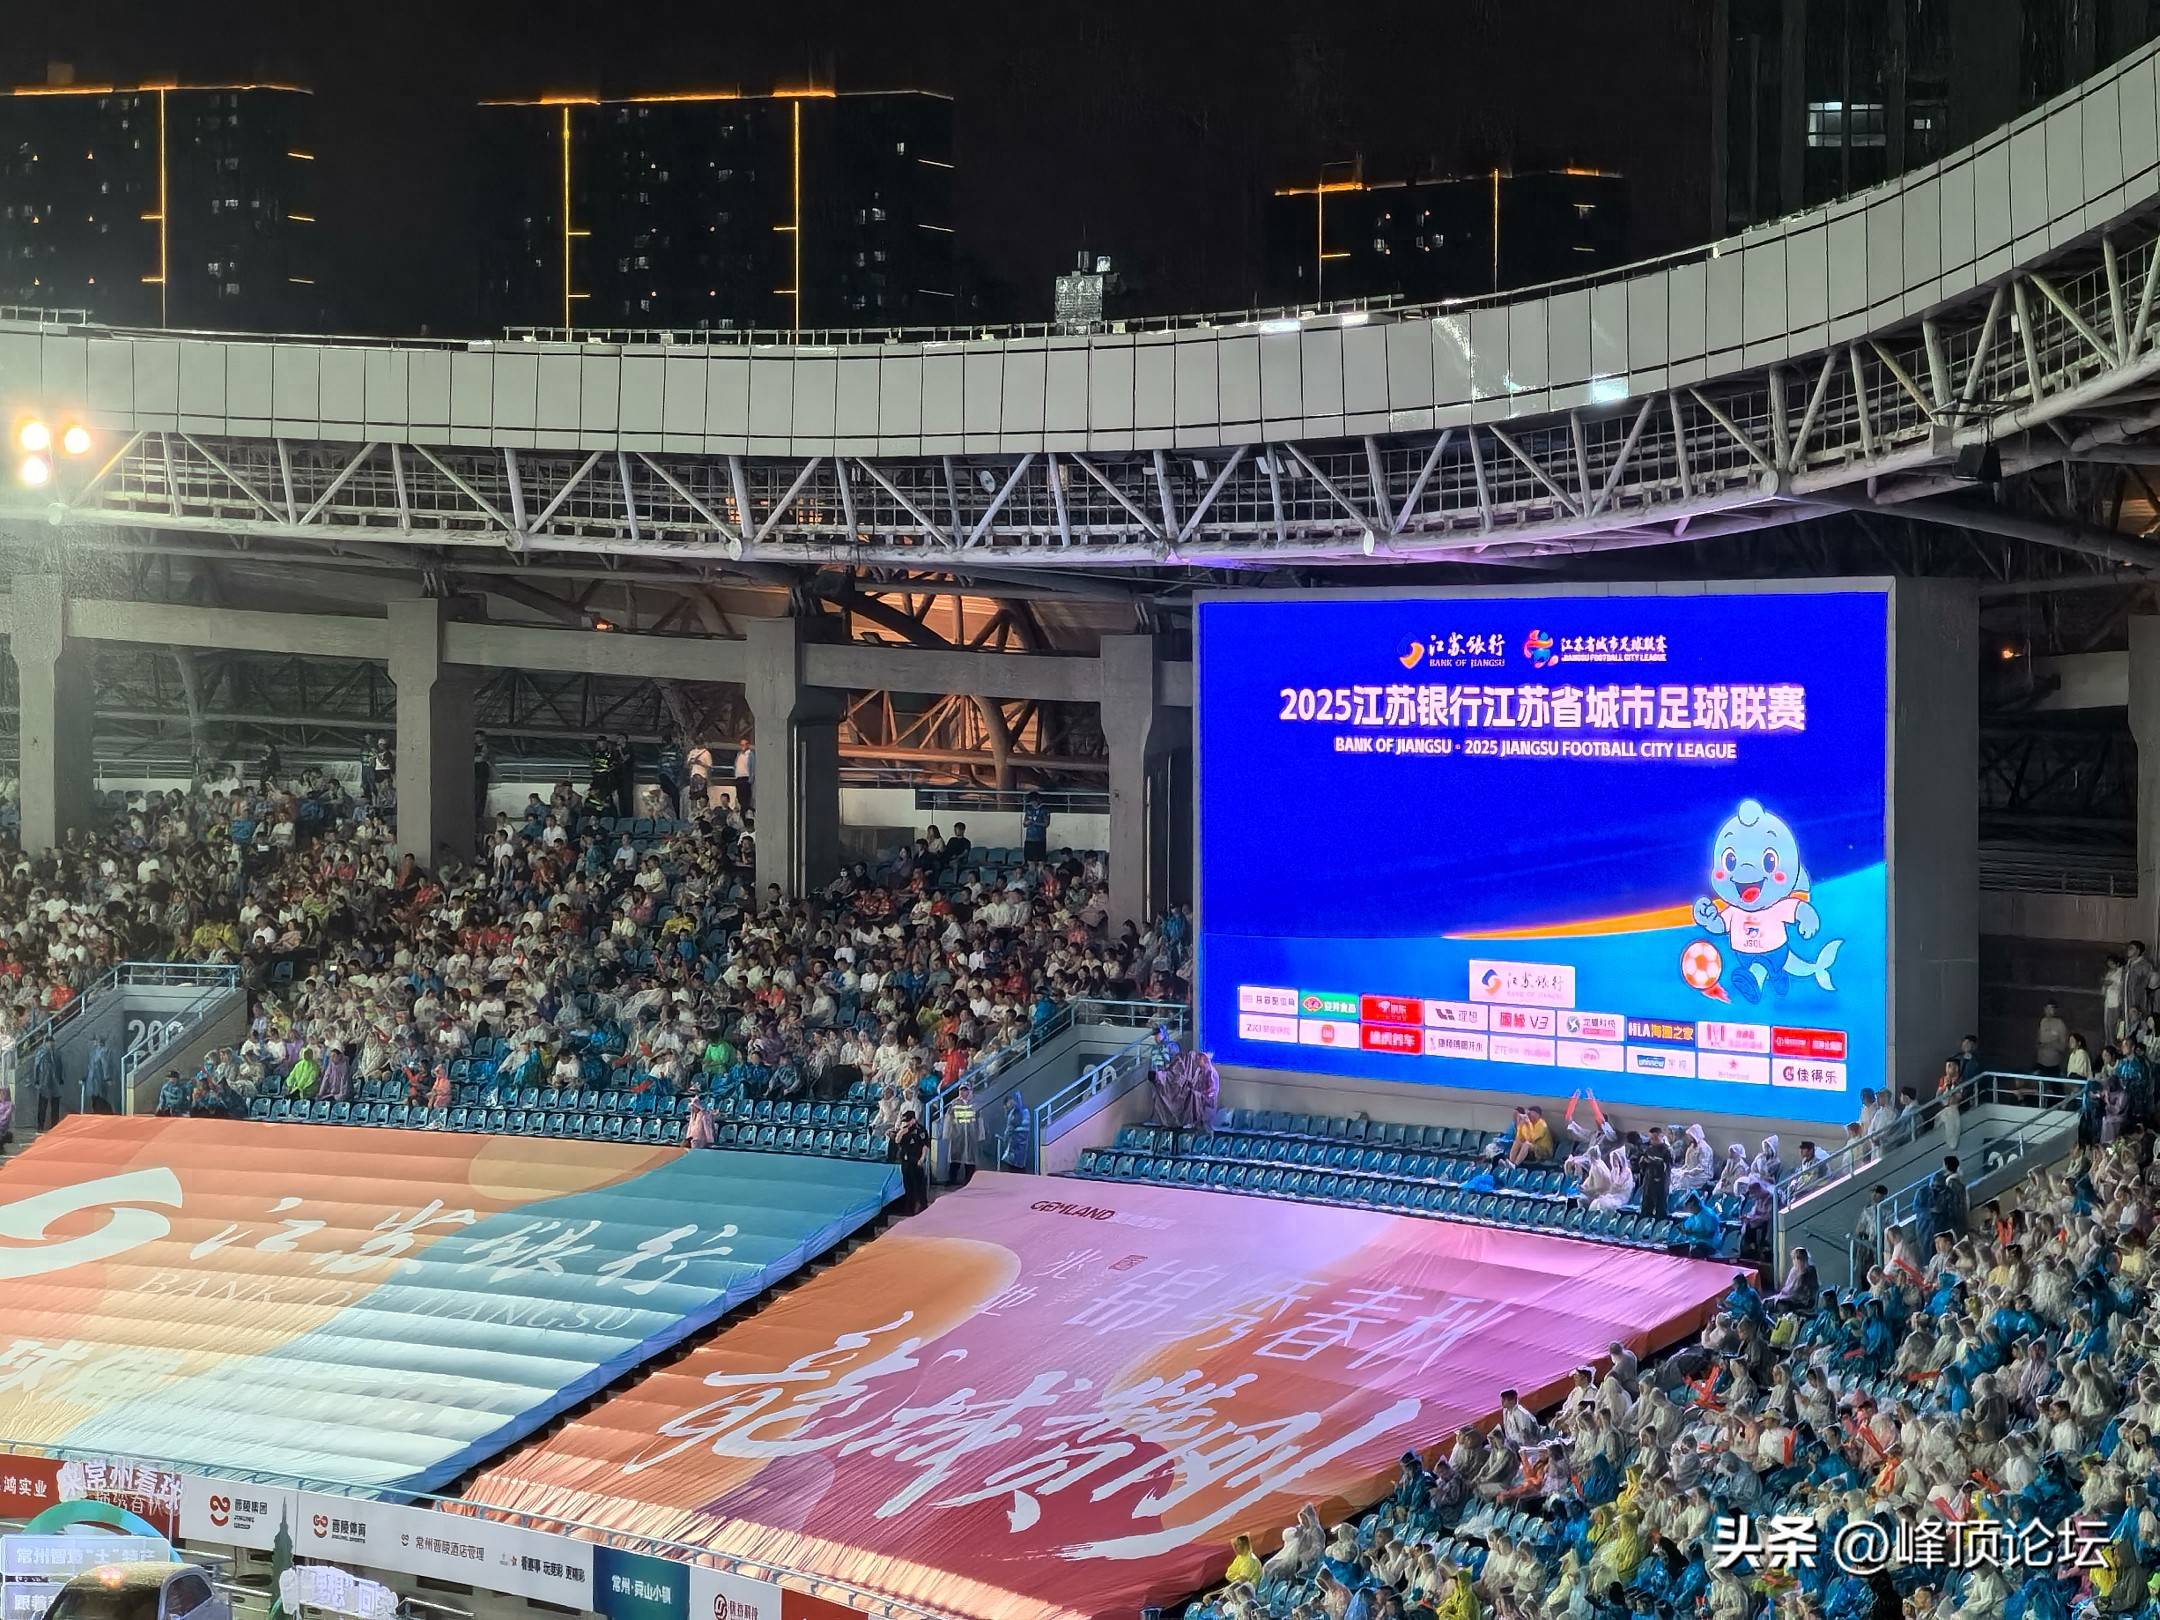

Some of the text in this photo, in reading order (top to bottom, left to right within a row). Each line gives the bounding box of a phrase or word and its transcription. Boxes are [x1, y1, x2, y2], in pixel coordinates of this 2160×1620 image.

[1429, 632, 1505, 656] 江苏银行
[1429, 659, 1505, 668] BANK OF JIANGSU
[1280, 685, 1806, 730] 2025江苏银行江苏省城市足球联赛
[1335, 737, 1372, 753] BANK
[1376, 738, 1393, 753] OF
[1396, 738, 1452, 755] JIANGSU
[1465, 740, 1498, 755] 2025
[1501, 740, 1558, 757] JIANGSU
[1562, 742, 1637, 757] FOOTBALL
[1640, 743, 1673, 757] CITY
[1677, 743, 1736, 759] LEAGUE
[1530, 1016, 1549, 1030] V3
[1797, 1067, 1838, 1085] 佳得乐
[1031, 1200, 1115, 1220] GEMLAND
[134, 1272, 297, 1302] BANK
[1062, 1259, 1518, 1376] 锦绣春秋
[0, 1475, 47, 1498] 鸿实业
